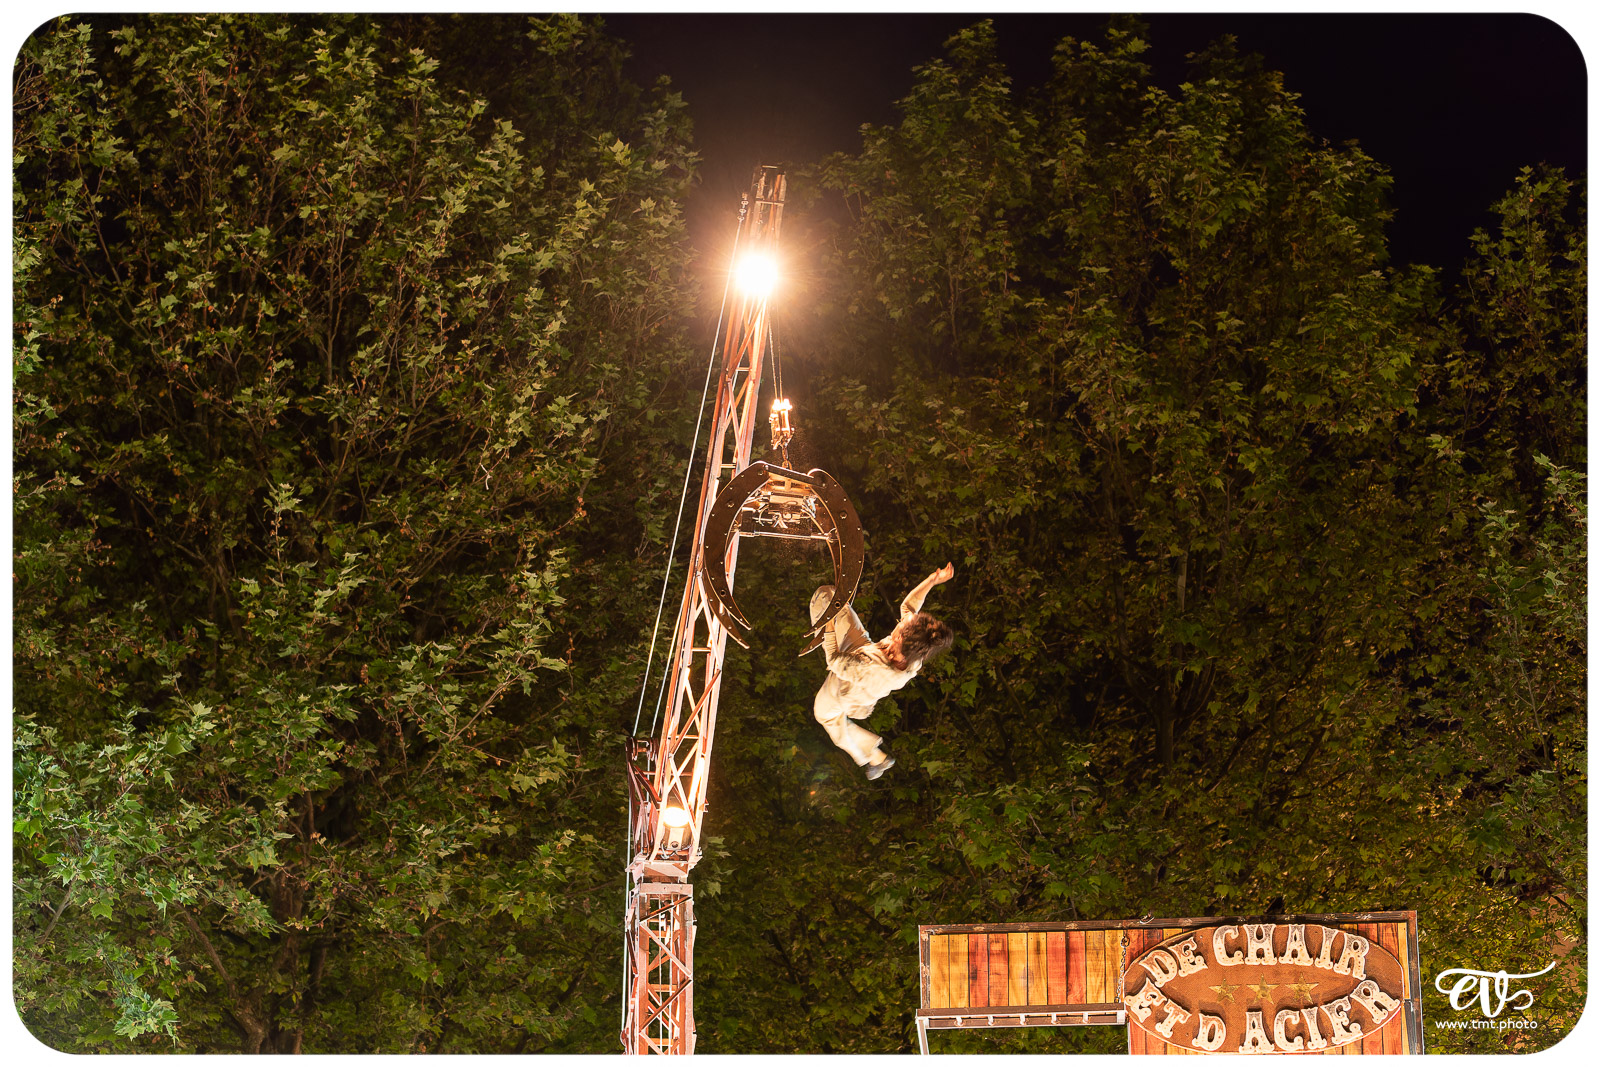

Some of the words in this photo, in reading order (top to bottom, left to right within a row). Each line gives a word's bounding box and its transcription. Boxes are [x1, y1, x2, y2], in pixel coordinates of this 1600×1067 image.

[1139, 937, 1208, 987] DE
[1213, 924, 1370, 980] CHAIR
[1125, 978, 1192, 1038] ET
[1239, 979, 1400, 1053] ACIER
